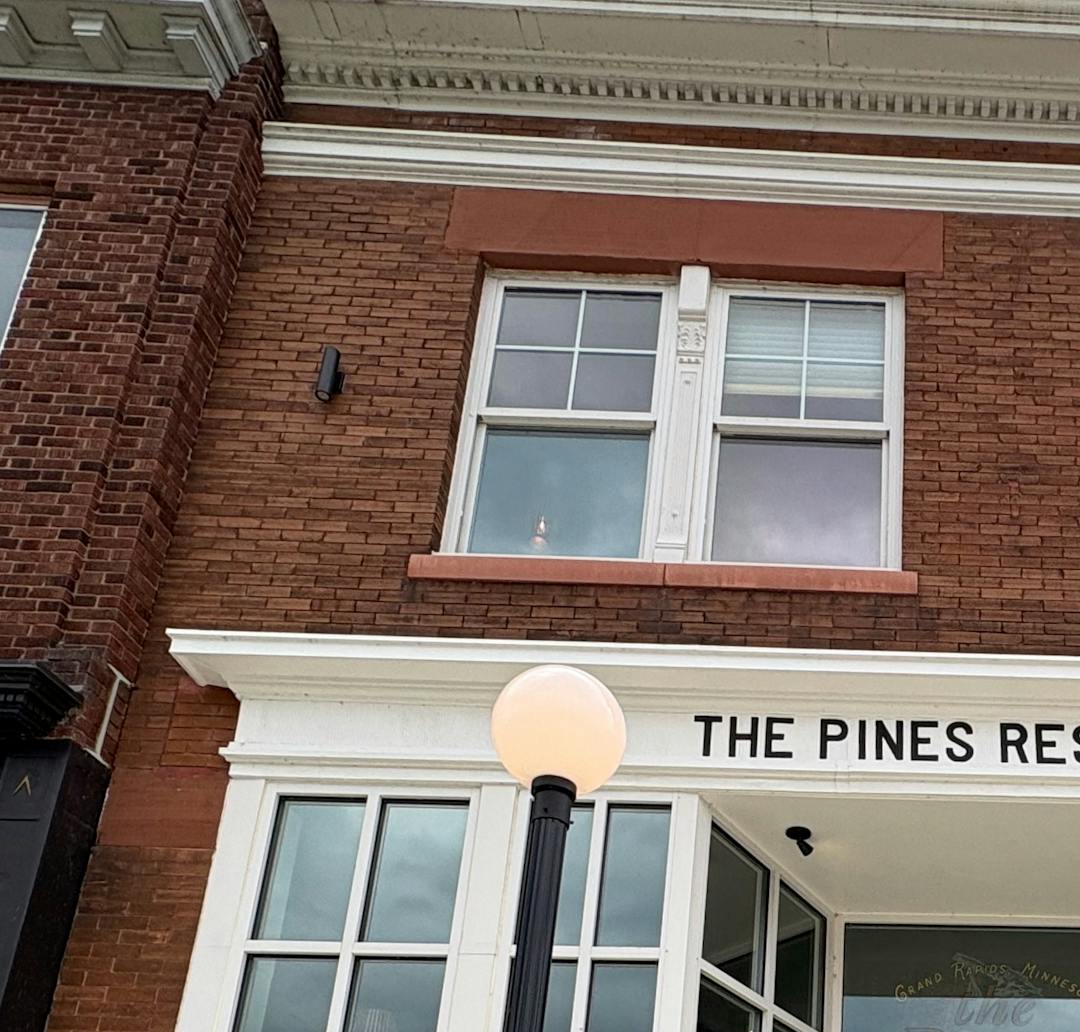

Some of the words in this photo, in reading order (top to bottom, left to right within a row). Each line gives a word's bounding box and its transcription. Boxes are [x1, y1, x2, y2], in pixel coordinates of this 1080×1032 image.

[694, 714, 794, 760] THE
[818, 718, 975, 762] PINES
[894, 972, 943, 1003] GRAND
[953, 984, 1037, 1026] the
